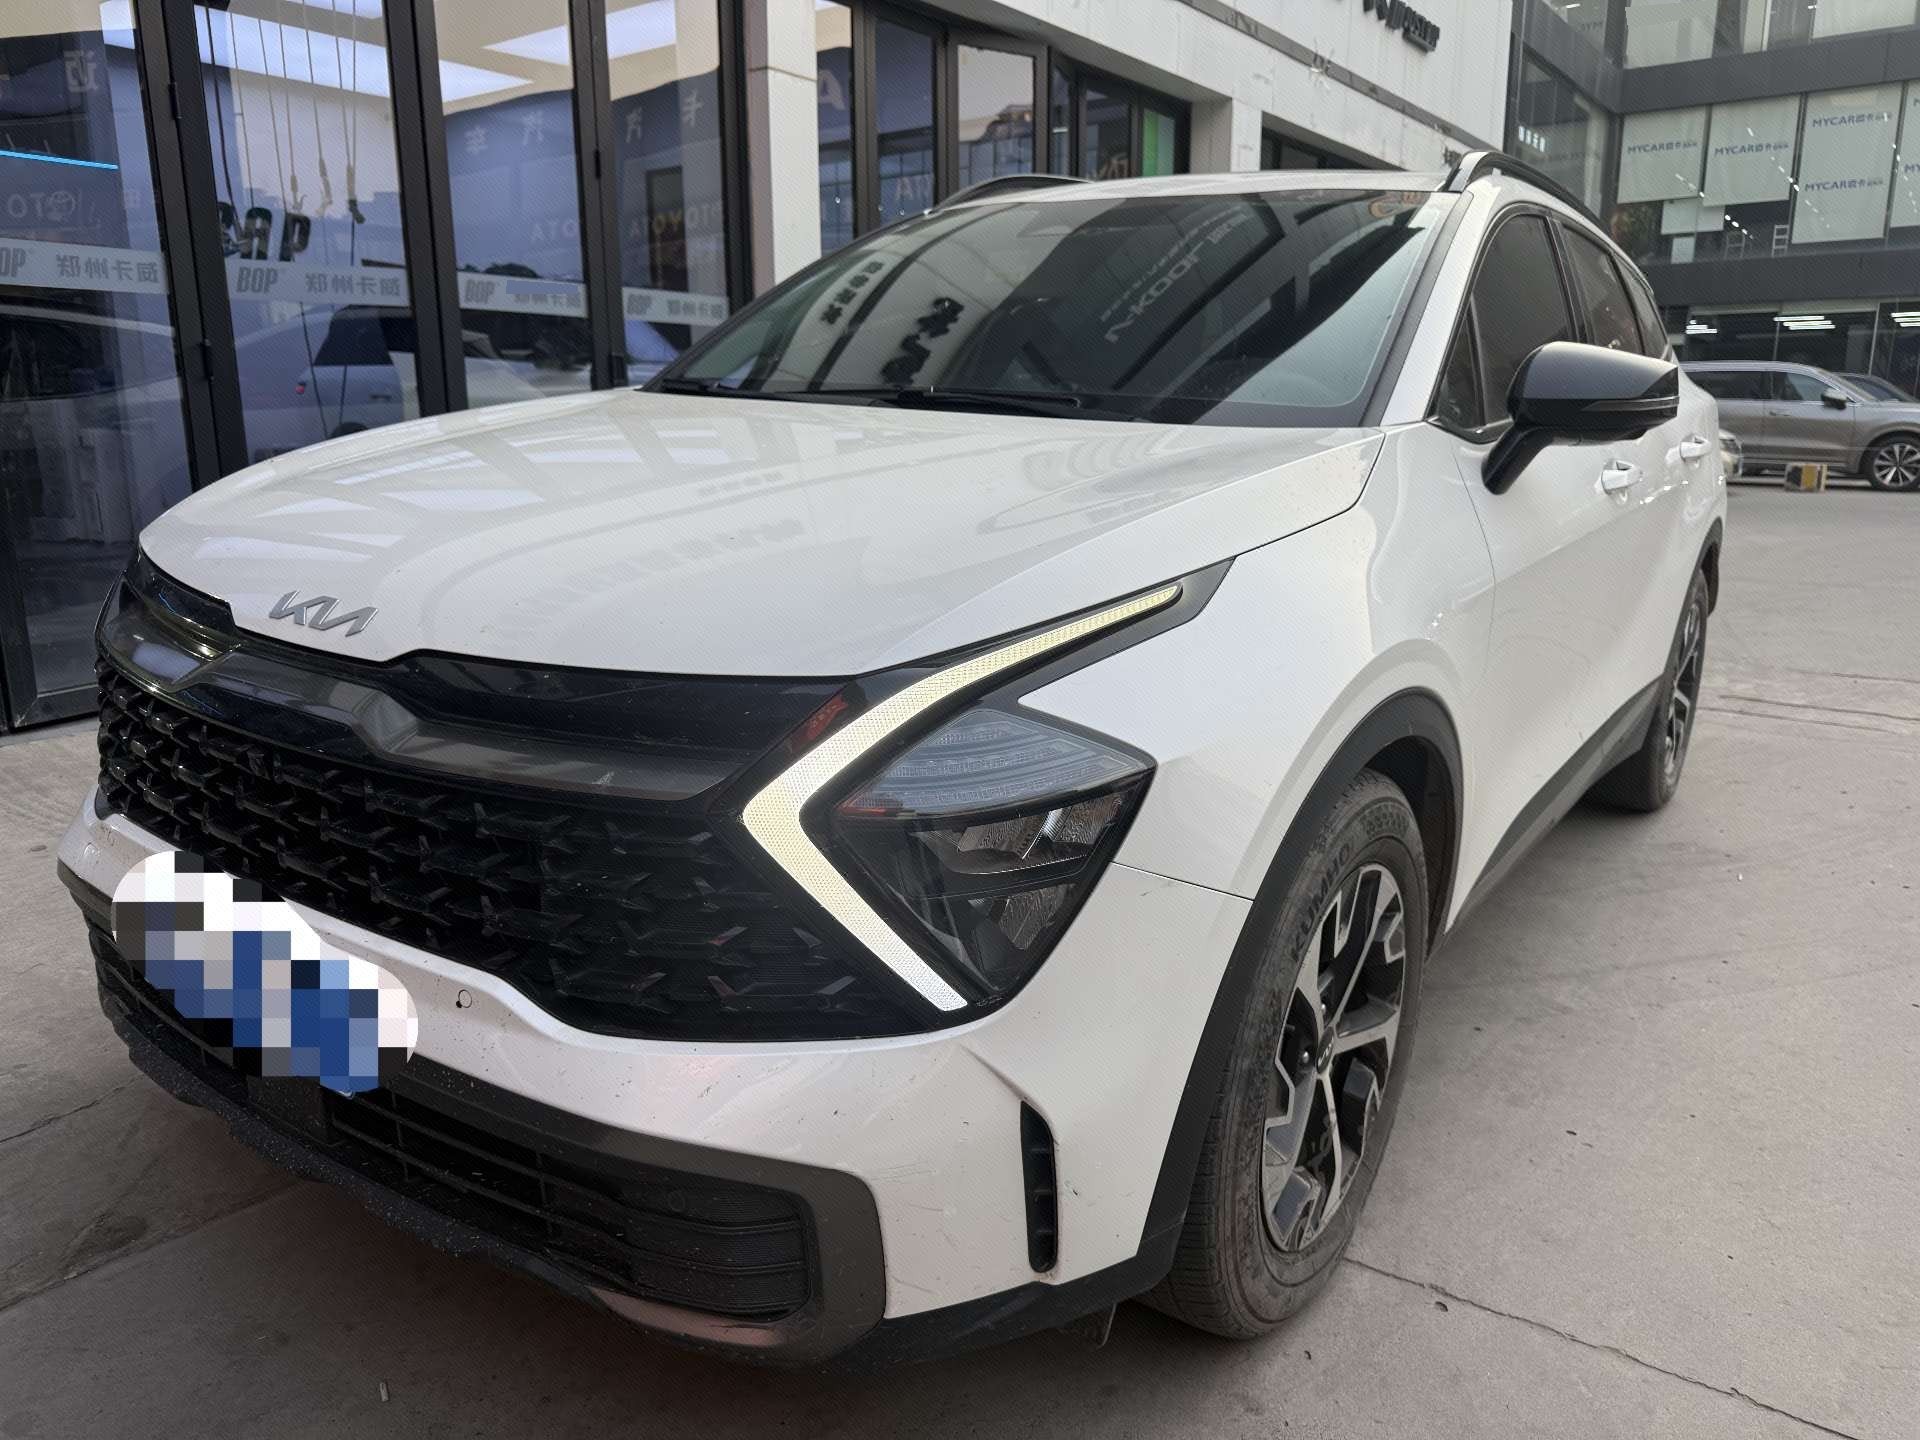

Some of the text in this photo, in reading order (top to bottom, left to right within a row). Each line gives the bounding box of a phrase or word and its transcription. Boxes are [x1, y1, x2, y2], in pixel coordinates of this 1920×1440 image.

[0, 247, 26, 278] OP
[55, 253, 160, 284] 郑州卡威
[236, 266, 279, 293] BOP
[305, 272, 400, 296] 郑州卡威
[269, 590, 378, 637] KIA
[1293, 842, 1350, 962] KUMHO
